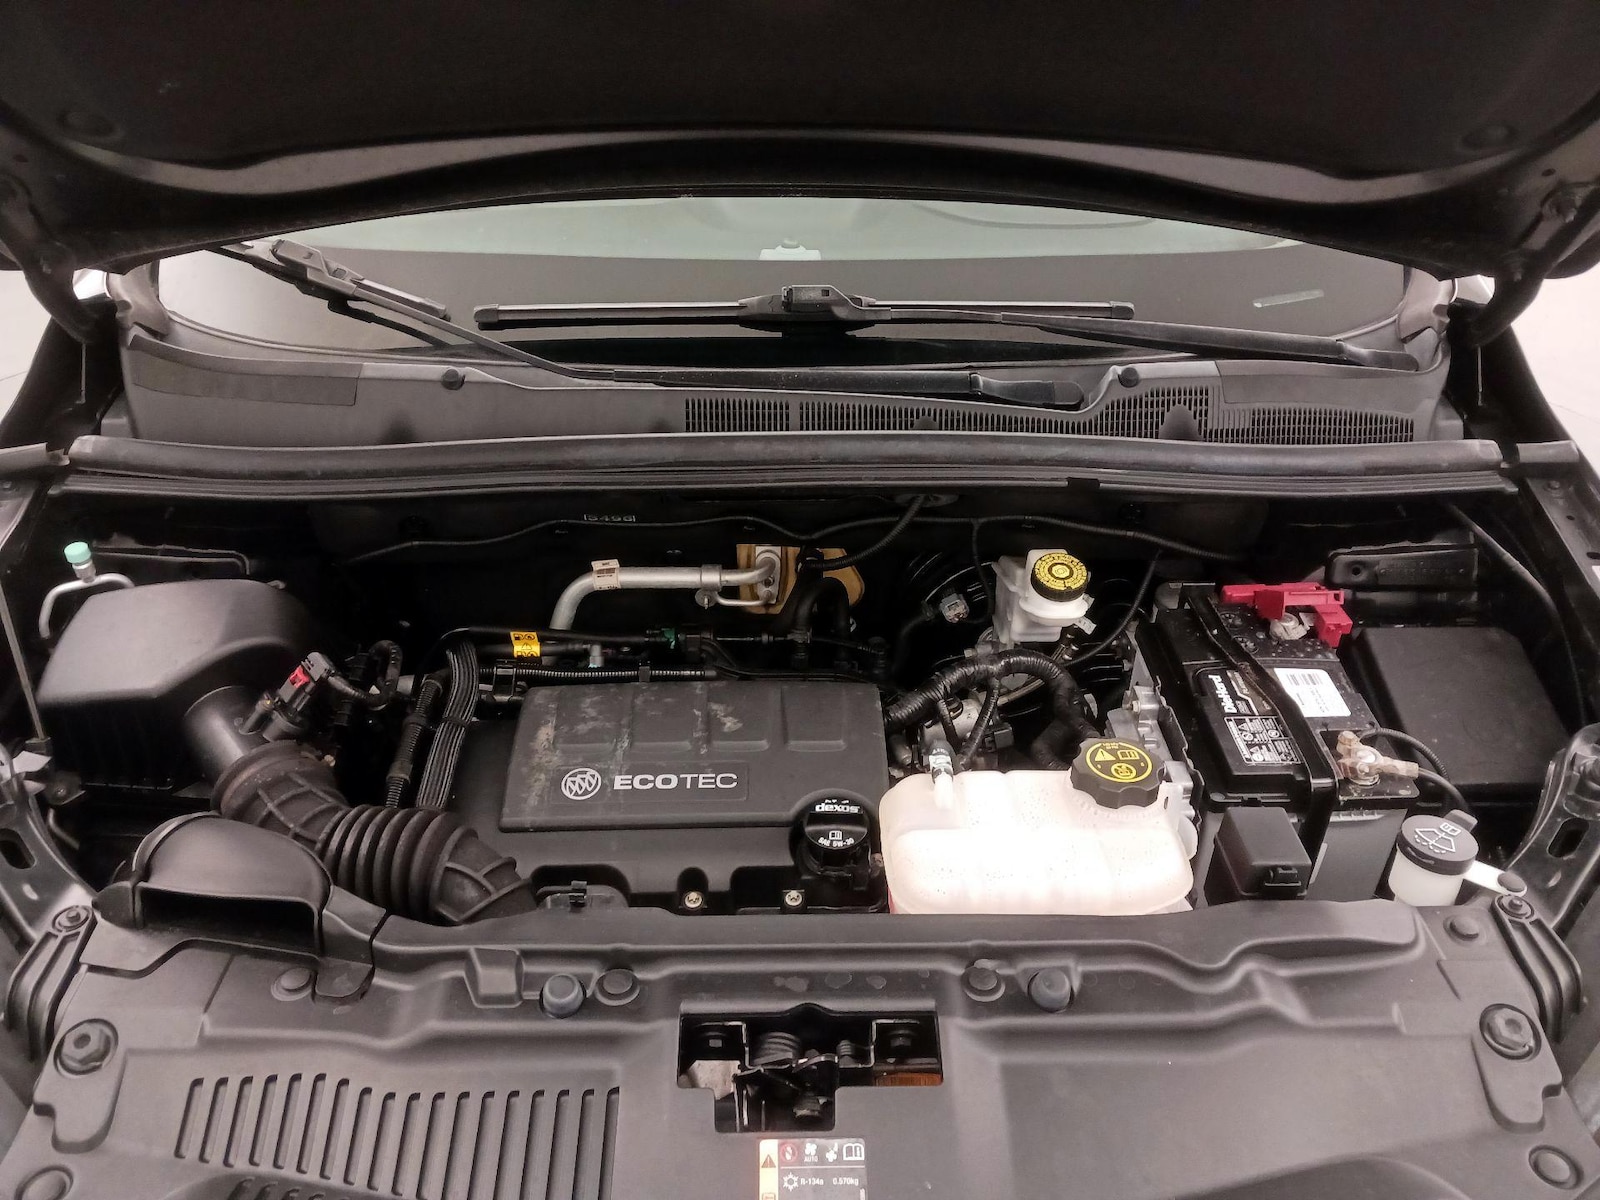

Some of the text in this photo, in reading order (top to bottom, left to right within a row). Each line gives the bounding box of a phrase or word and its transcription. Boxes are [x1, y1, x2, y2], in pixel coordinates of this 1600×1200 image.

[1208, 674, 1238, 714] DieHard
[613, 773, 738, 790] ECOTEC
[815, 802, 861, 813] dexos
[800, 1177, 859, 1187] R-134a 0.570kg
